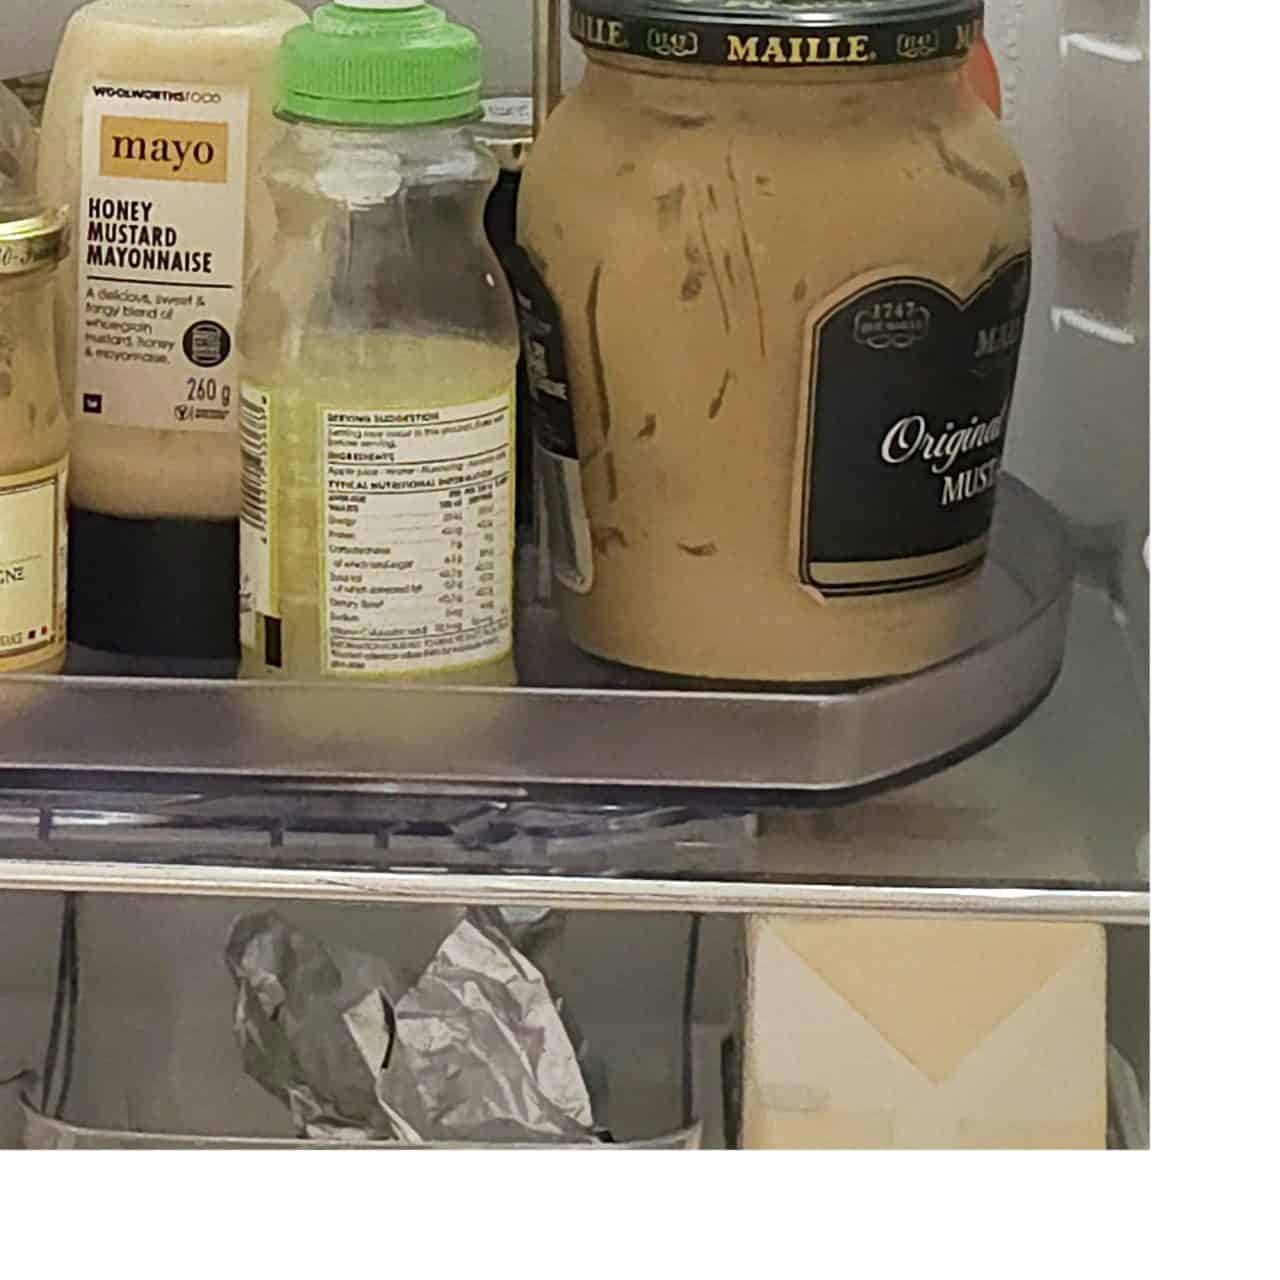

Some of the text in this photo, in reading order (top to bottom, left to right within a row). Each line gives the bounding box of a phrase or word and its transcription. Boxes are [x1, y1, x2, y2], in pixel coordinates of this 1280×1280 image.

[727, 35, 871, 63] MAILLE
[112, 135, 215, 172] mayo
[88, 197, 153, 222] HONEY
[87, 221, 178, 247] MUSTARD
[86, 245, 213, 273] MAYONNAISE
[186, 376, 231, 407] 260 g
